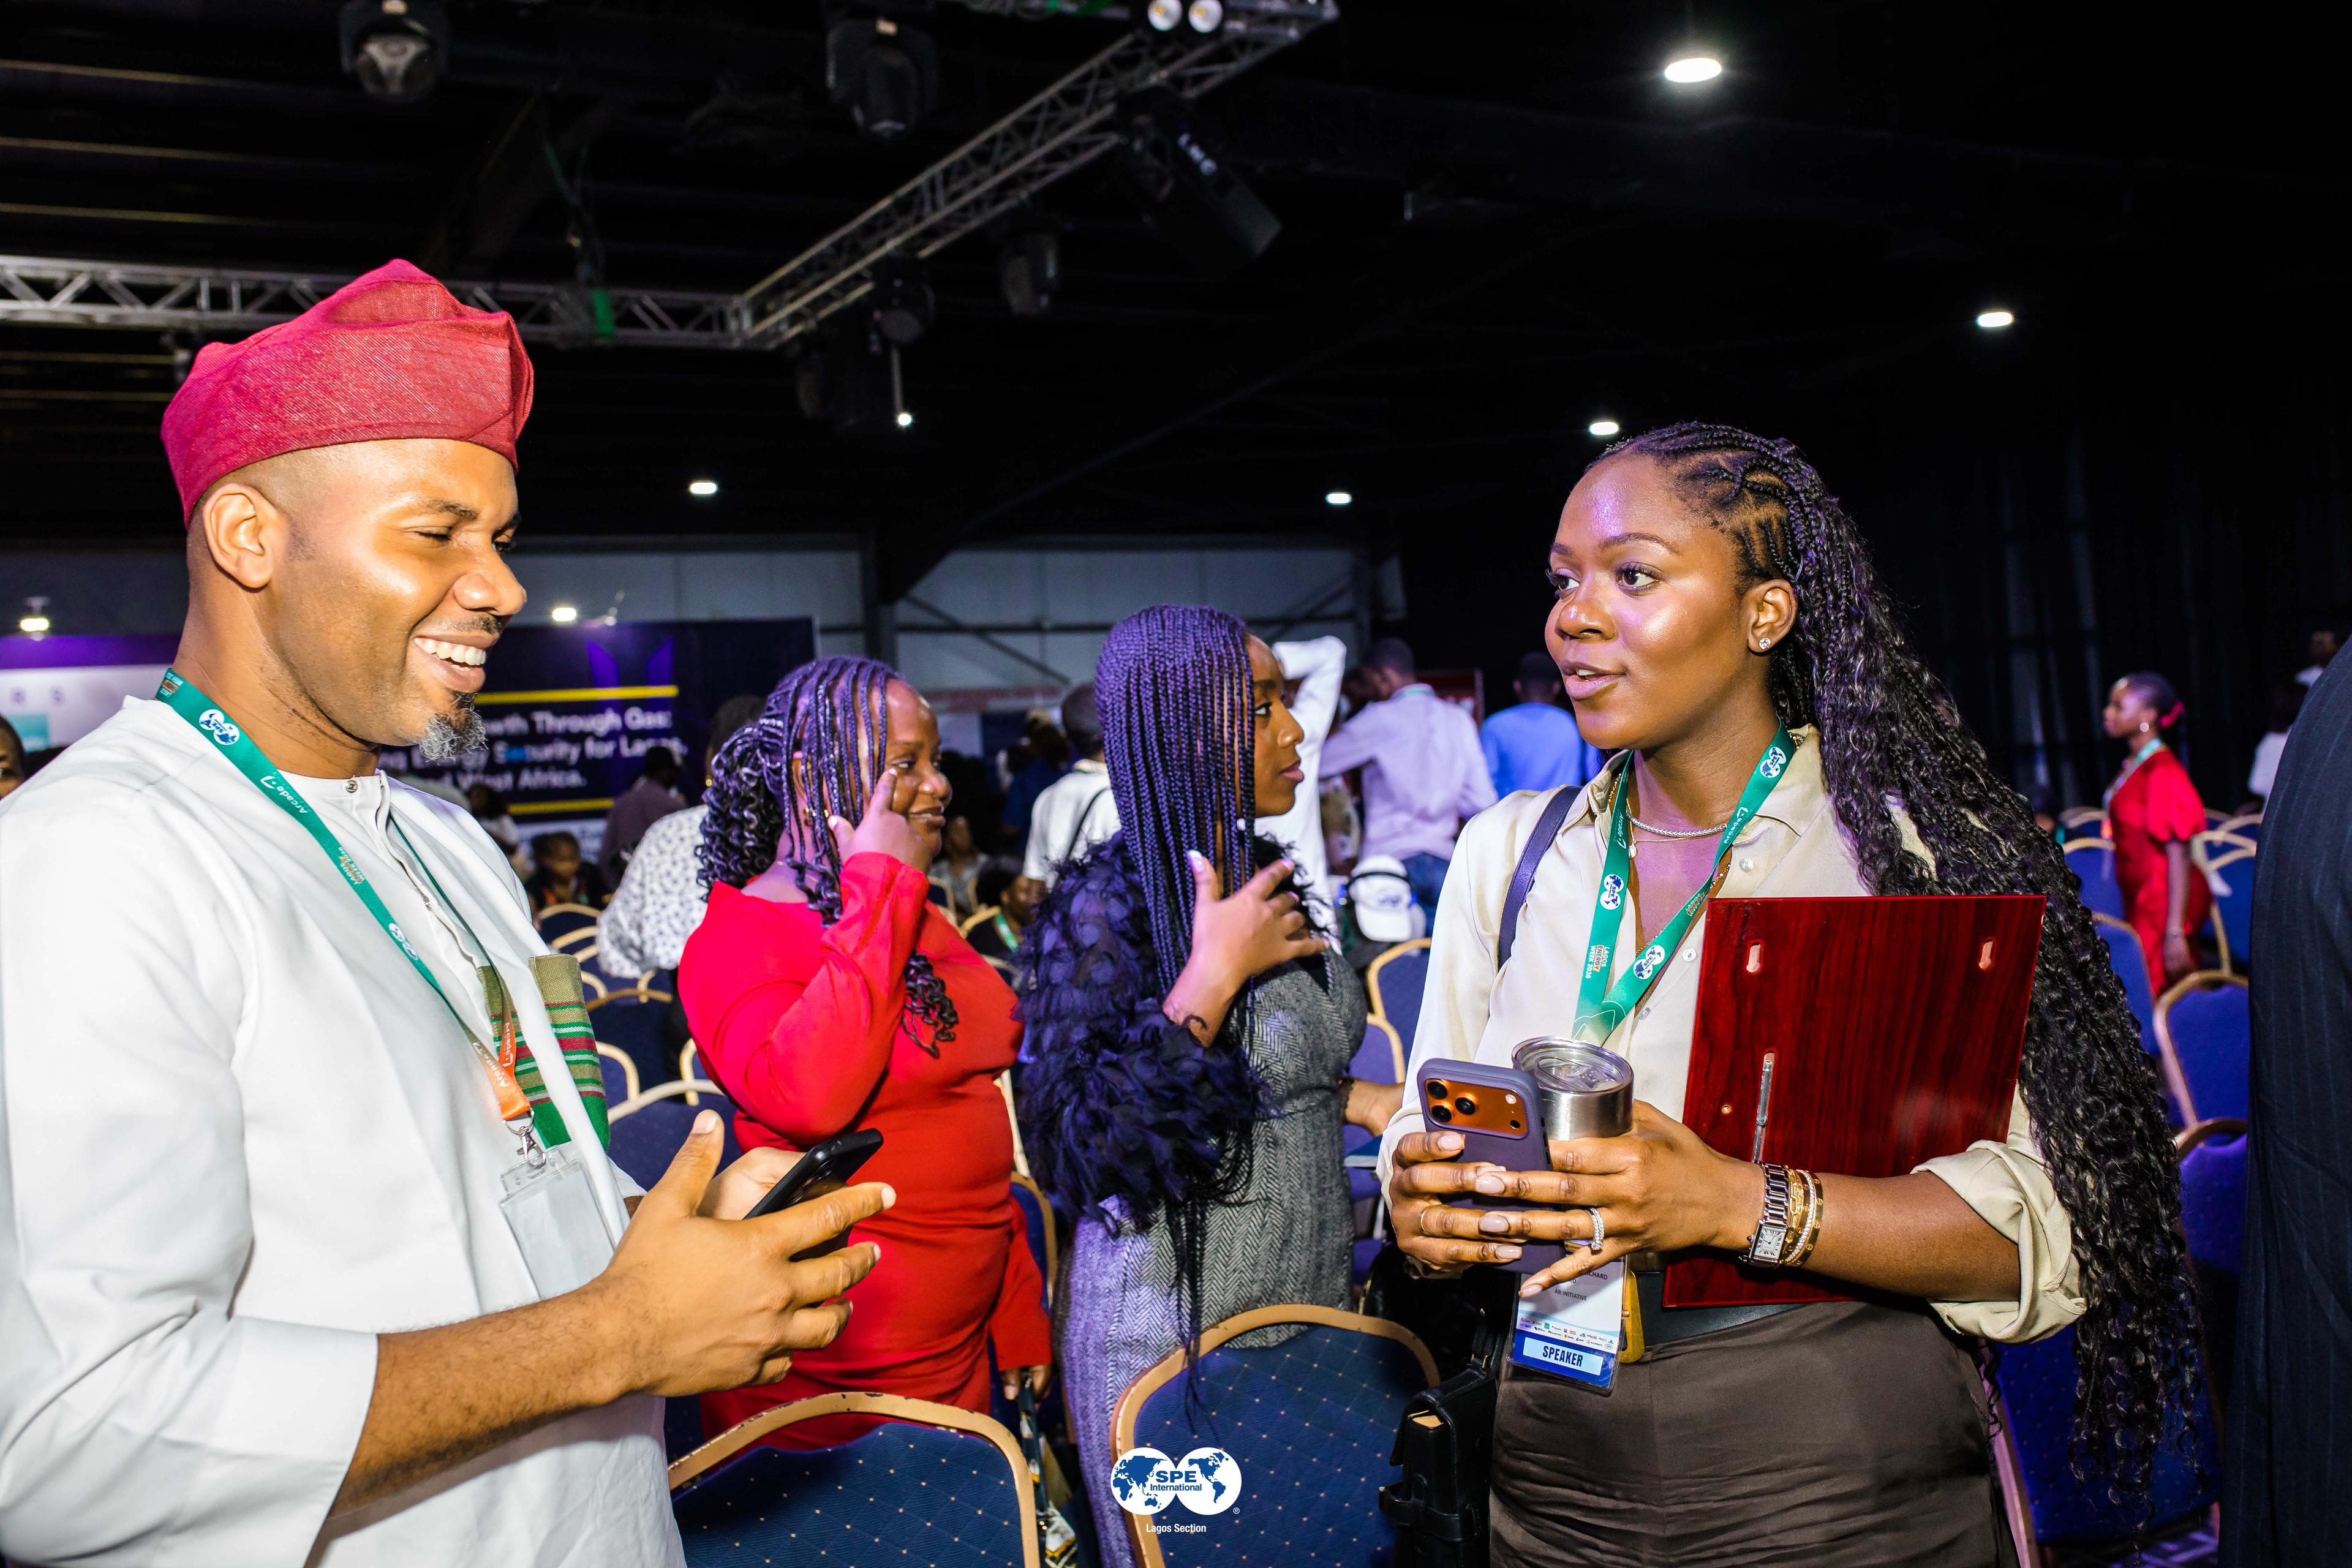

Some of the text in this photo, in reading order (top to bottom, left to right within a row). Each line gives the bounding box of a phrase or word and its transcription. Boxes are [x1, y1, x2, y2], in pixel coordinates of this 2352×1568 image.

[532, 707, 622, 736] Through
[584, 736, 616, 759] for
[277, 785, 308, 813] Arcade
[1724, 818, 1743, 844] Arcade
[1588, 945, 1597, 963] WEEK
[1594, 945, 1604, 970] ENERGY
[1601, 946, 1610, 967] LAGOS
[1587, 1270, 1608, 1280] ICHARD
[1562, 1291, 1588, 1301] INITIATIVE
[1542, 1345, 1583, 1367] SPEAKER
